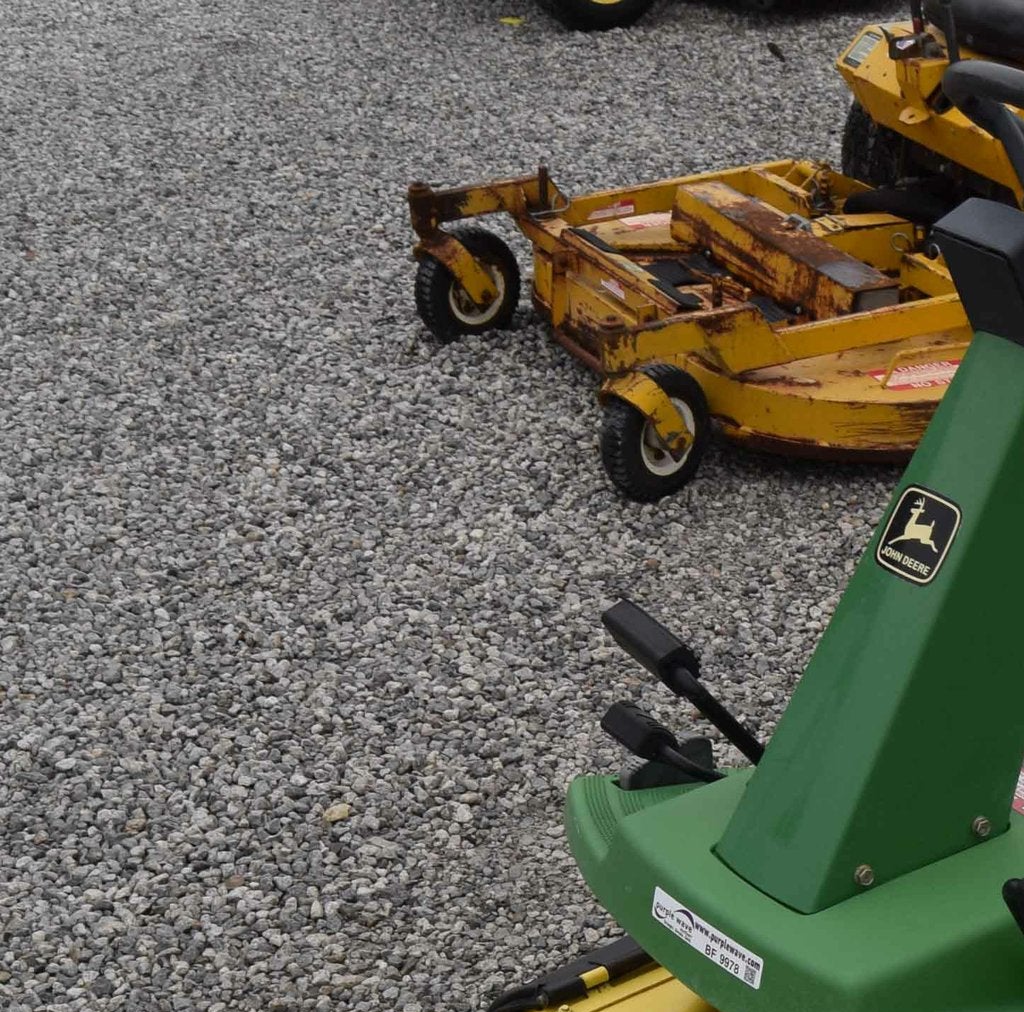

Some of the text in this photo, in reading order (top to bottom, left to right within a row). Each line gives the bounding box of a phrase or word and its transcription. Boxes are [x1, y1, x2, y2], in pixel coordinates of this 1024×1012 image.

[881, 545, 931, 576] JOHN DEERE
[694, 921, 761, 972] www.purplewave.com
[704, 944, 740, 975] BF 9978
